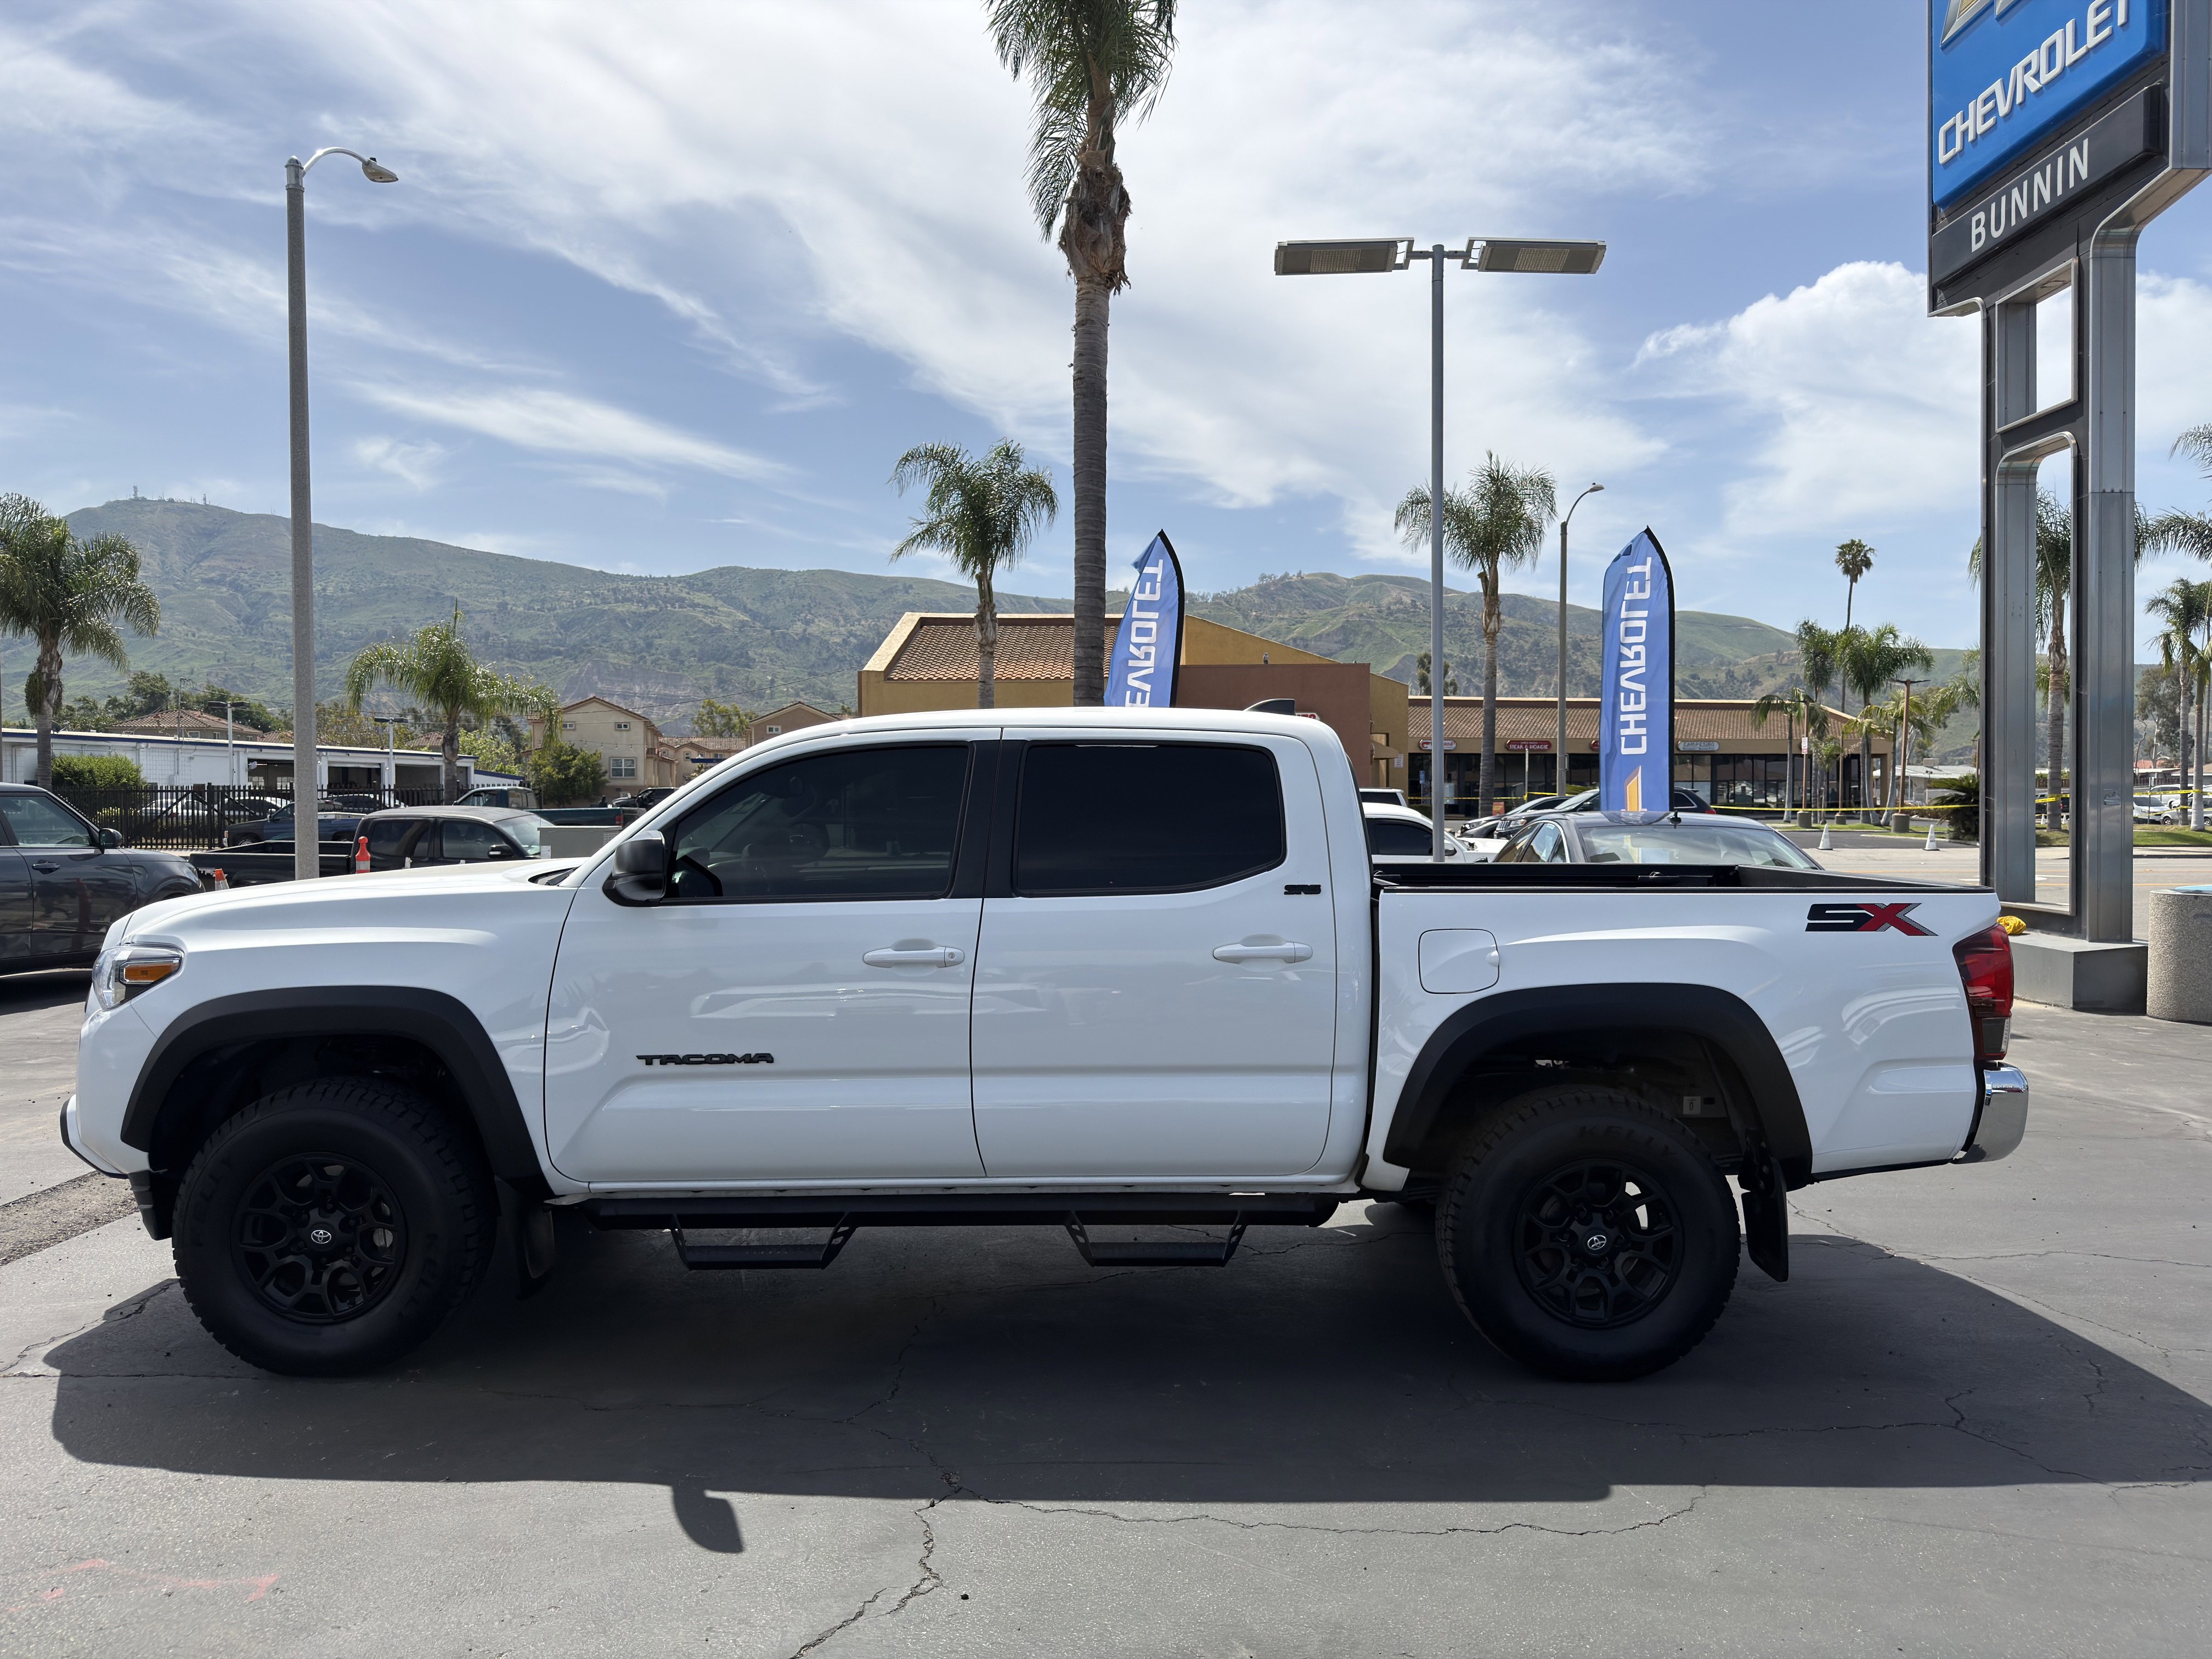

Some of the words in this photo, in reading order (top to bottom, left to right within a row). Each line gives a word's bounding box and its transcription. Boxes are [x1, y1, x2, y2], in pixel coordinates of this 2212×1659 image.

[1971, 137, 2089, 253] BUNNIN
[1805, 902, 1939, 936] SX
[636, 1053, 774, 1065] TACOMA
[1578, 1124, 1677, 1157] KELLY
